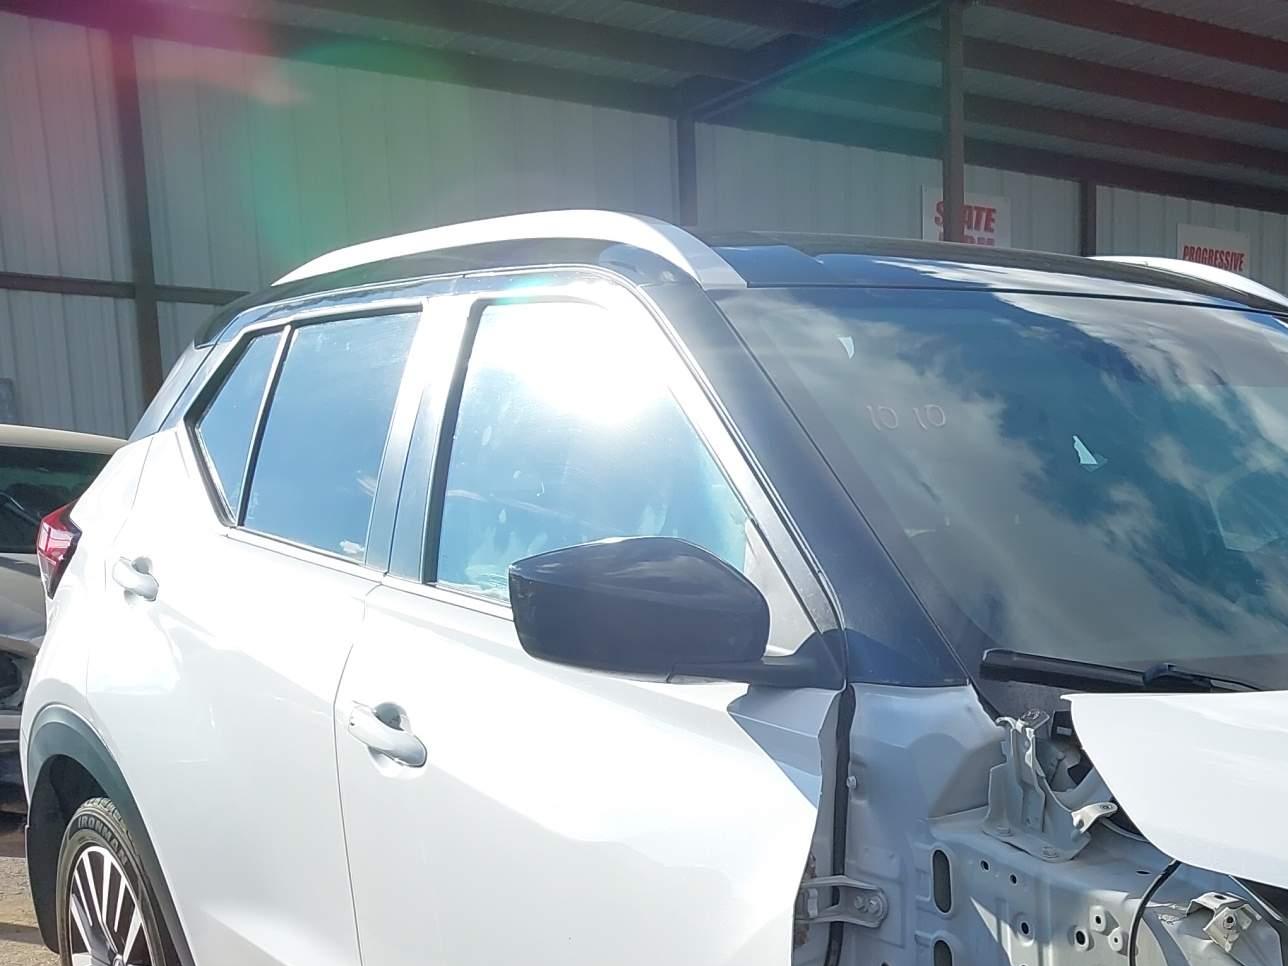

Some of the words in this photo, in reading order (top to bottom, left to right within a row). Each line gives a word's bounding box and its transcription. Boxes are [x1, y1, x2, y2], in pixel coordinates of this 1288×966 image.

[934, 200, 997, 233] SATE
[1183, 245, 1245, 272] PROGRESSIVE
[77, 814, 128, 865] IRONMAN
